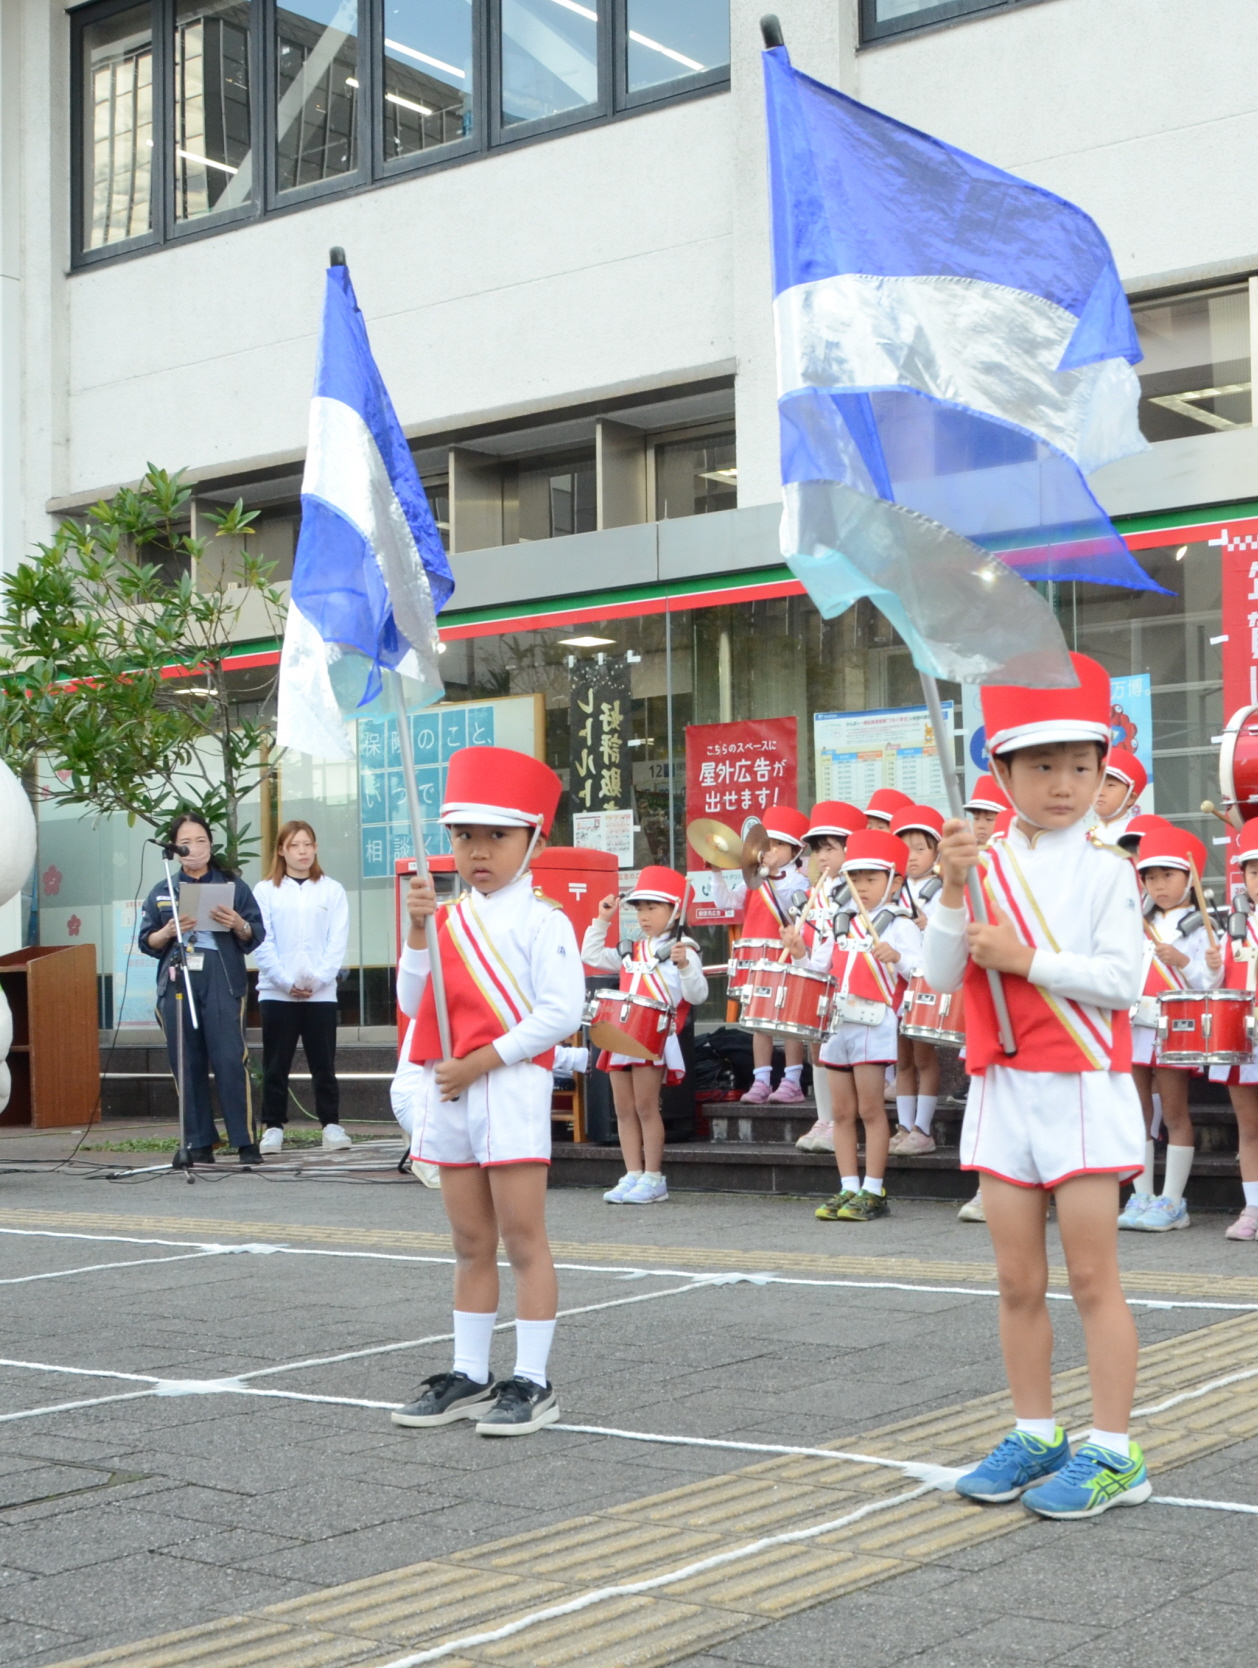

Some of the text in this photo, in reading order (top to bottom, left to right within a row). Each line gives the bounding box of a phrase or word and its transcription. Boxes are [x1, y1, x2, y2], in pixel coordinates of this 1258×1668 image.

[707, 741, 777, 755] こちらのスペースに
[699, 757, 787, 786] 屋外広告が
[705, 787, 779, 812] 出せます!
